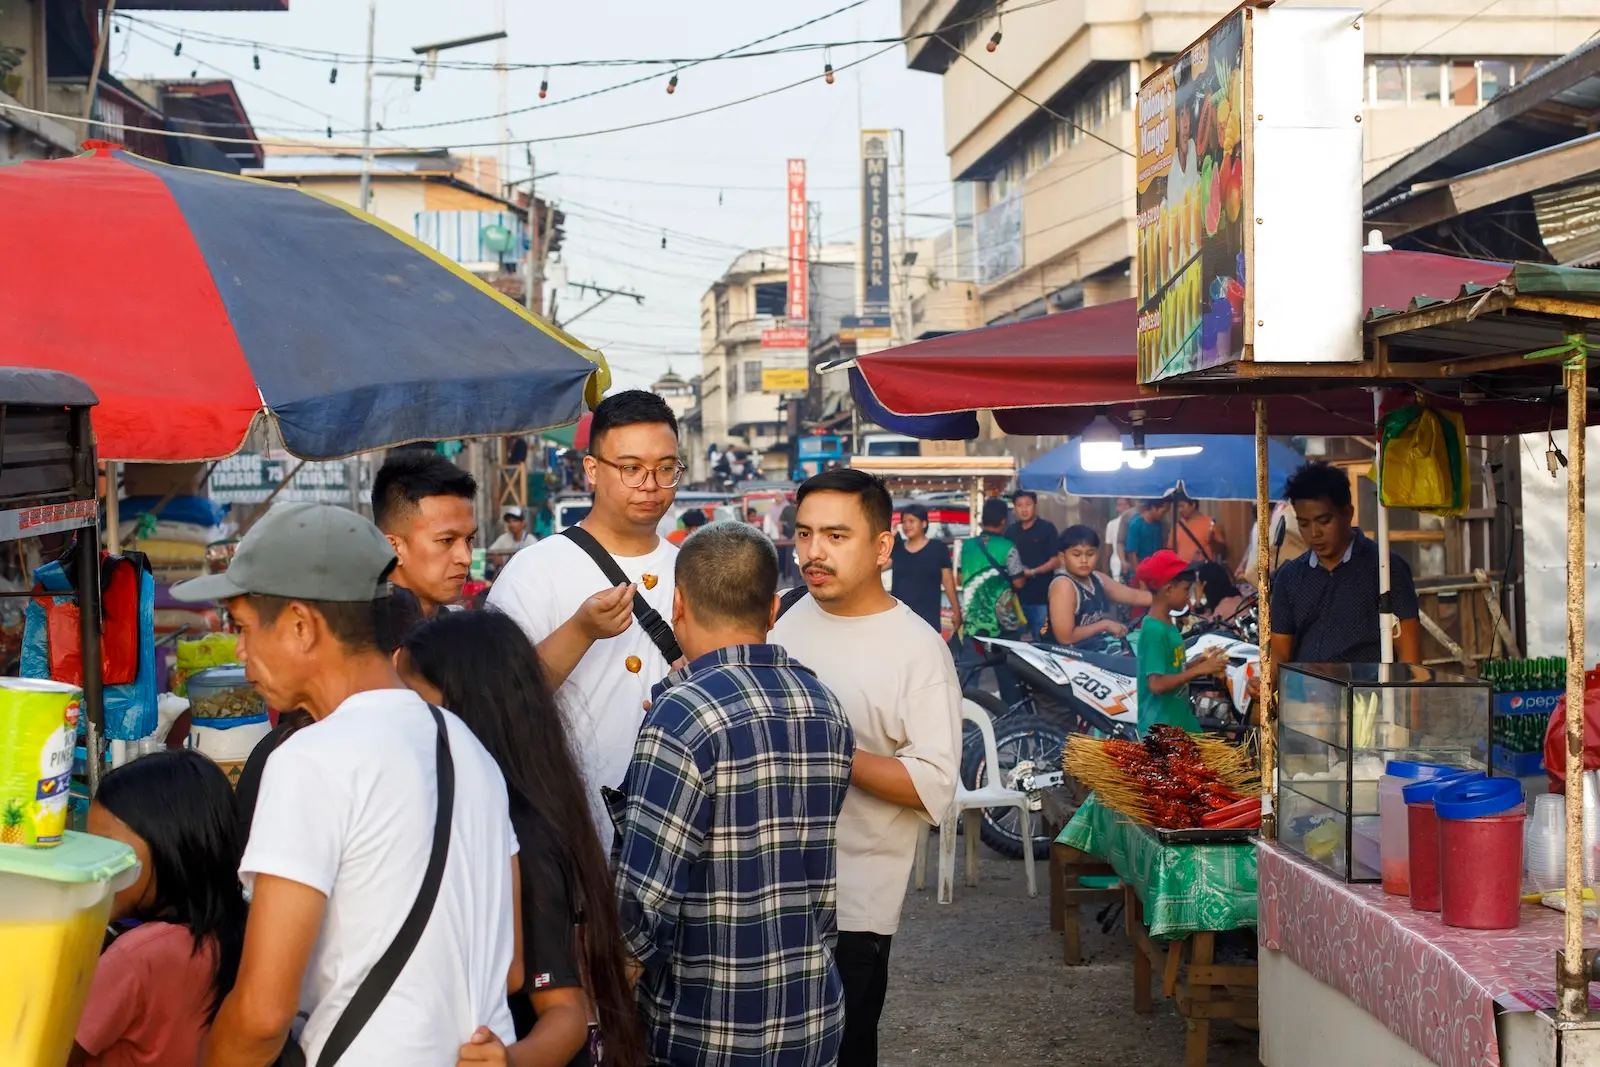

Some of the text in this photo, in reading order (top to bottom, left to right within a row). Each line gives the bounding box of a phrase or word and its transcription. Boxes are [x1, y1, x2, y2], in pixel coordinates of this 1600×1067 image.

[1140, 117, 1169, 157] Mangga
[867, 158, 884, 286] Metrobank
[212, 472, 261, 487] TAUSUG
[266, 466, 284, 482] 75
[1051, 646, 1083, 658] HONDA
[1072, 671, 1112, 700] 203
